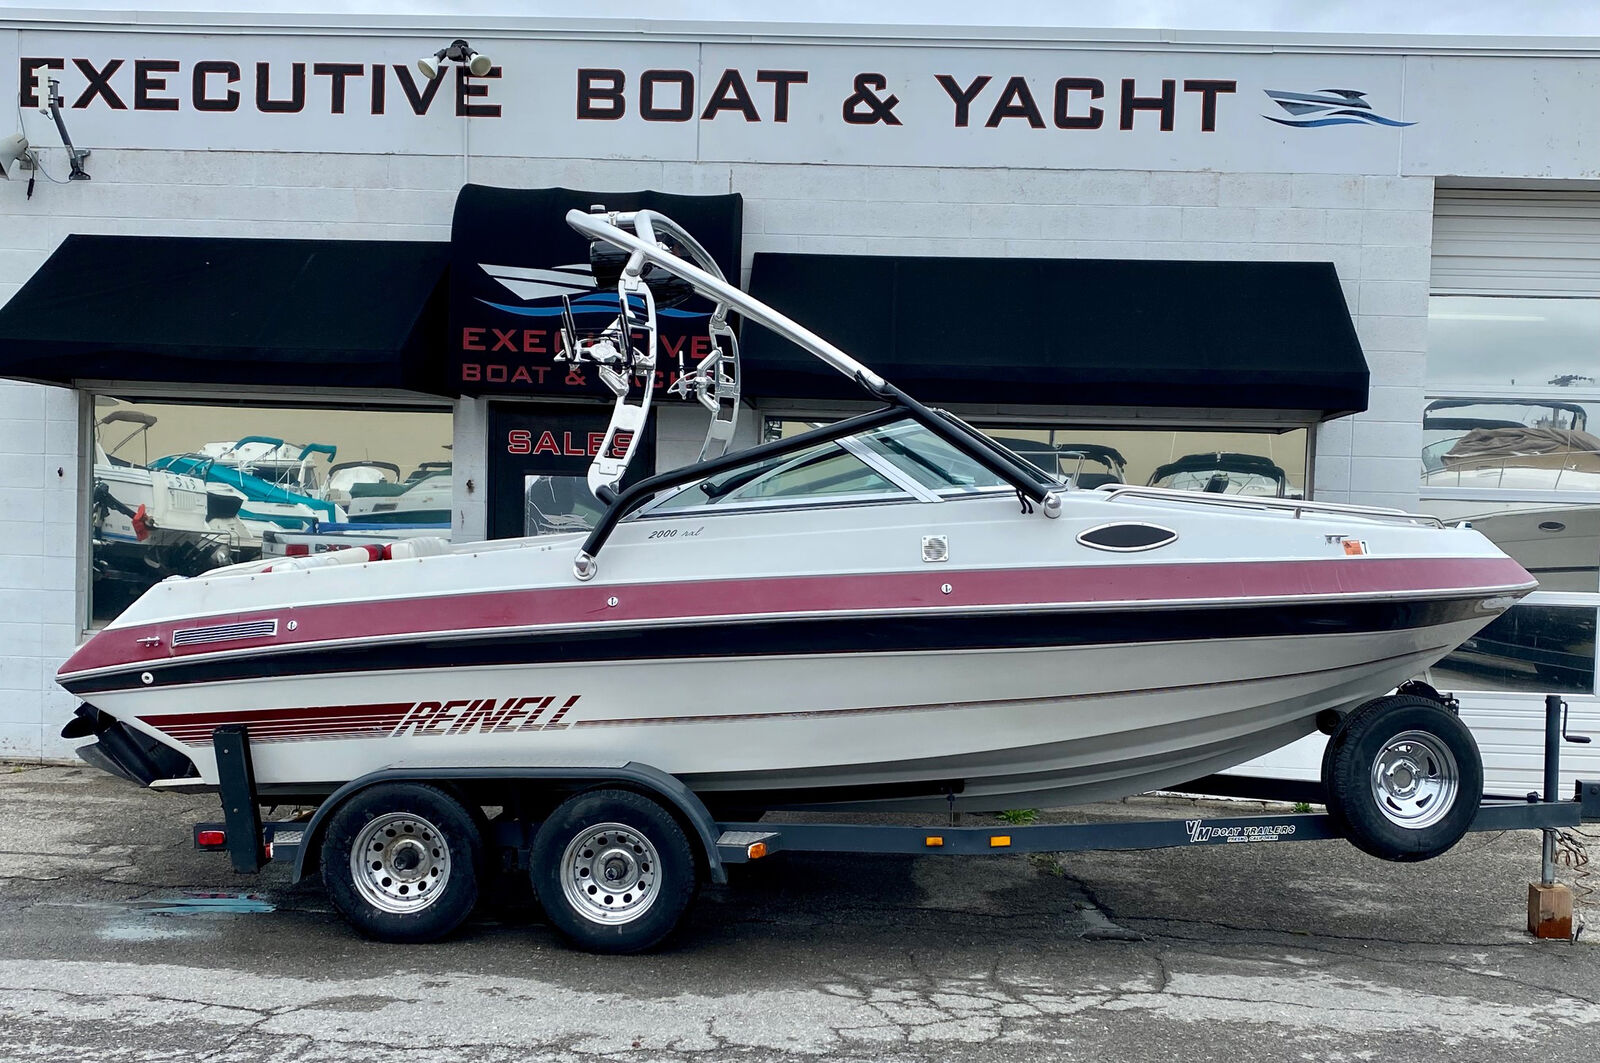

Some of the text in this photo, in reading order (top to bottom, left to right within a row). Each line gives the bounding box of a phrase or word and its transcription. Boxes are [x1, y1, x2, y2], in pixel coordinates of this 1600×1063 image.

[19, 57, 1237, 131] EXECUTIVE BOAT & YACHT
[462, 363, 587, 386] BOAT &
[507, 429, 635, 458] SALES
[648, 529, 678, 539] 2000
[392, 694, 582, 738] REINELL
[1211, 827, 1242, 837] BOAT
[1243, 825, 1296, 836] TRAILERS
